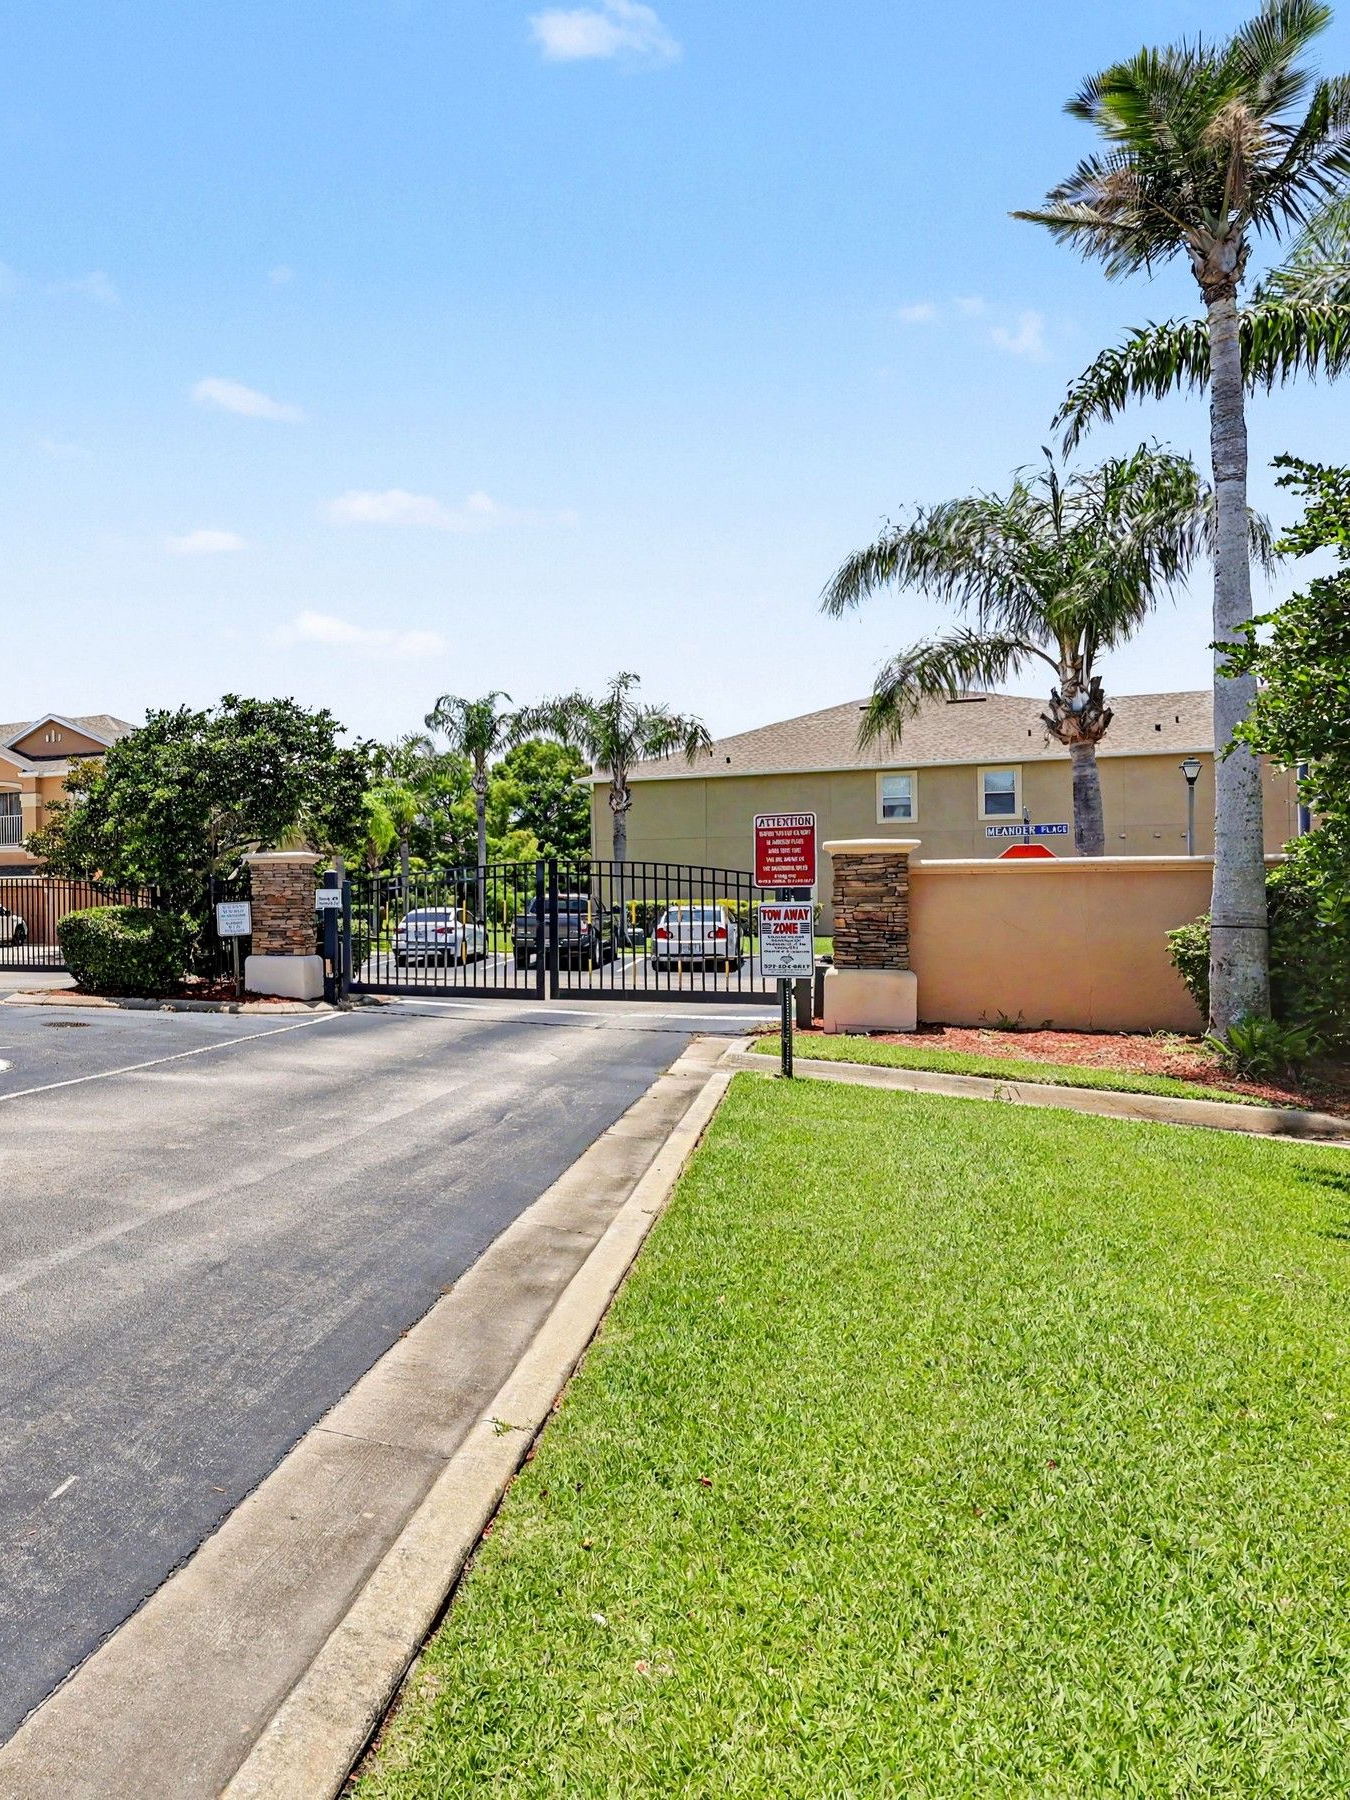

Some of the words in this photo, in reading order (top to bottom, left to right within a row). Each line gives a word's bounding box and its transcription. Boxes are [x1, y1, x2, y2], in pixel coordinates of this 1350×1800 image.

[759, 816, 812, 827] ATTENTION
[988, 826, 1035, 836] MEANDER
[761, 909, 781, 921] TOW
[784, 909, 809, 921] AWAY
[773, 923, 798, 934] ZONE
